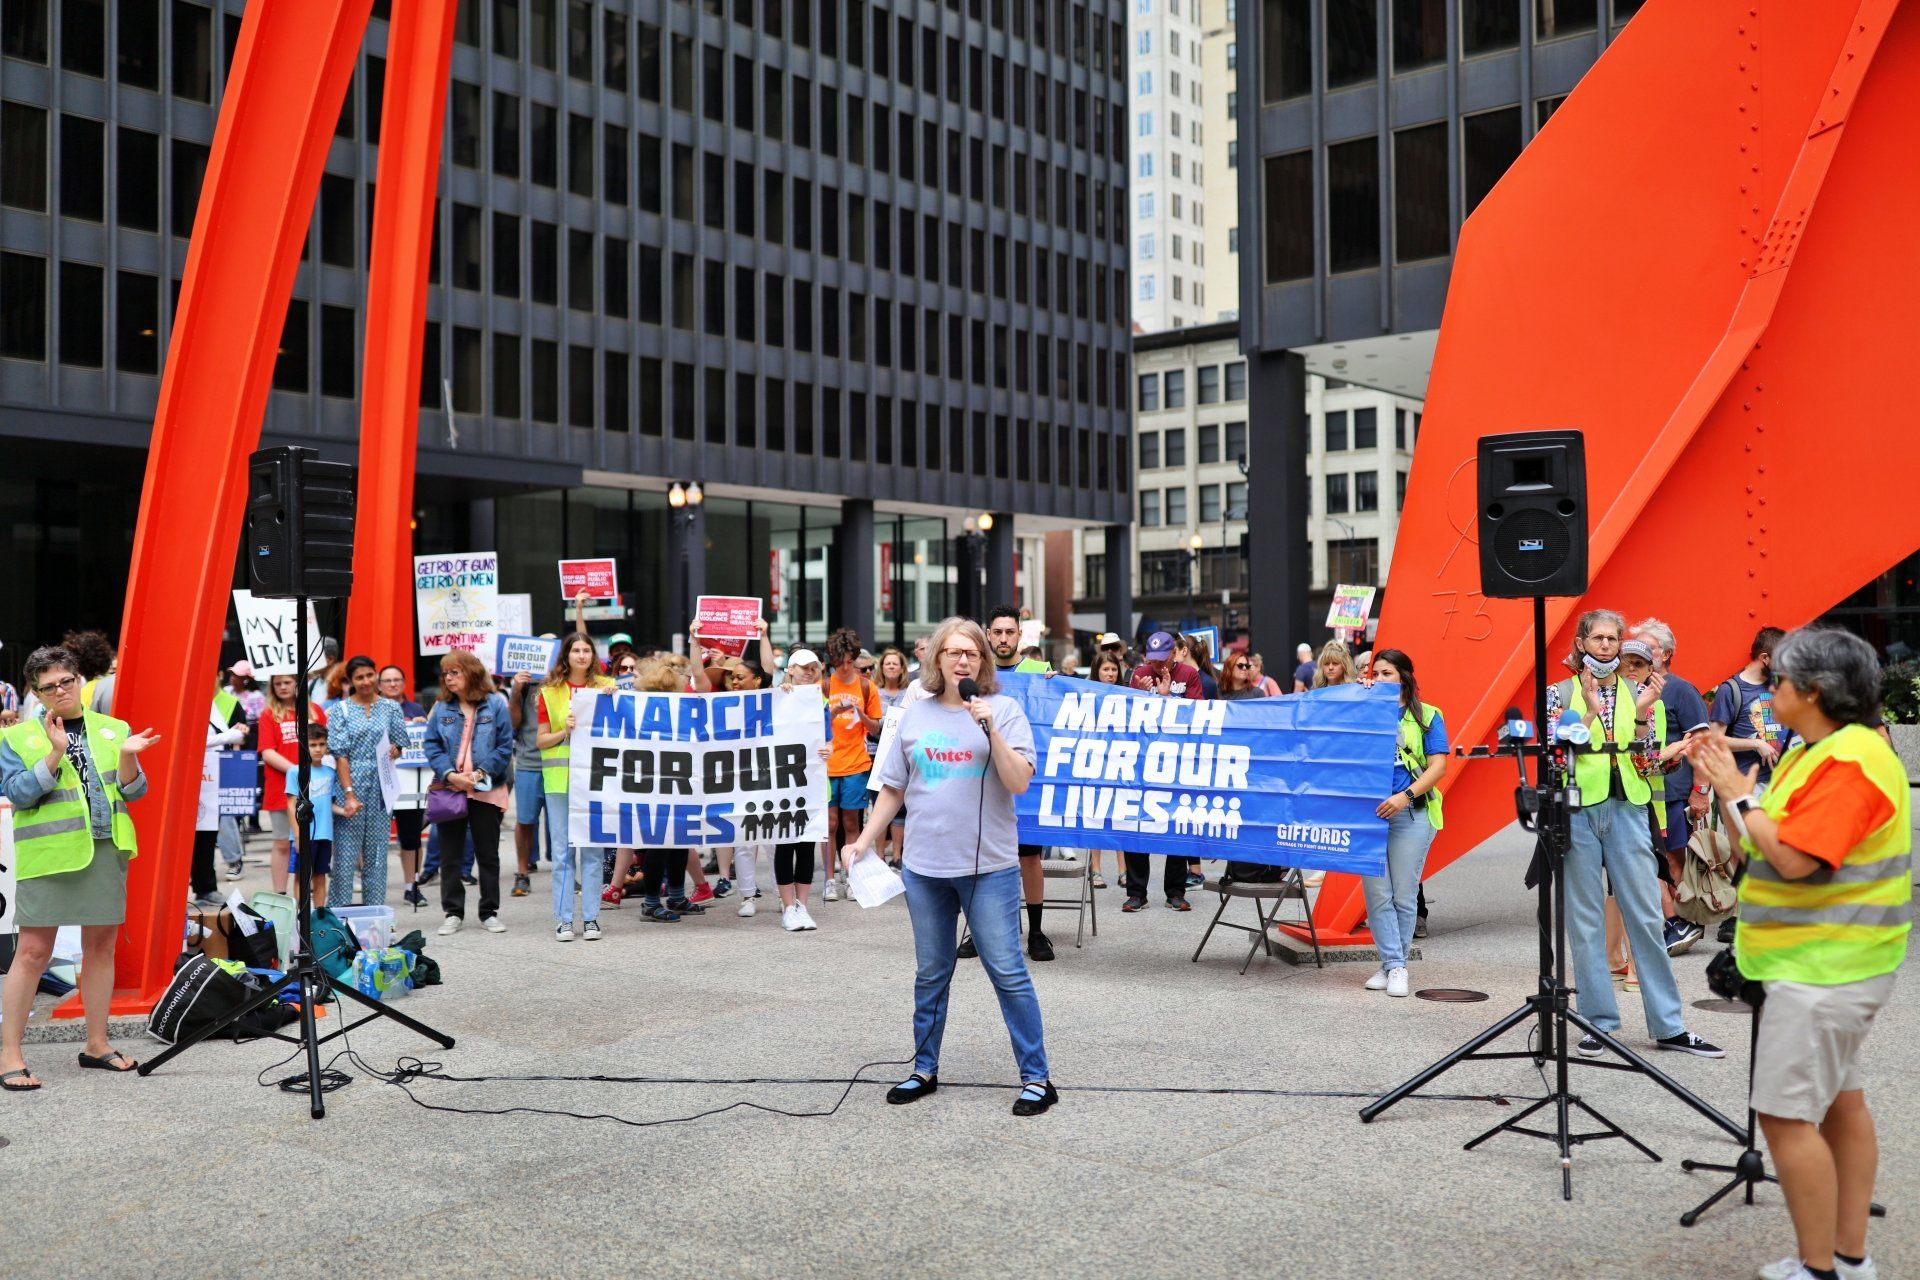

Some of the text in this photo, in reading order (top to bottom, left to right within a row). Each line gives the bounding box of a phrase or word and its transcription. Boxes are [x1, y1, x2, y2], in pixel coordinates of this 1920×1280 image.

[417, 558, 495, 575] GET RID OF GUNS
[417, 573, 494, 589] GET RID OF MEN
[246, 615, 283, 643] MY
[446, 620, 473, 630] PRETTY
[424, 634, 442, 647] WE
[508, 642, 542, 652] MARCH
[507, 651, 546, 662] FOR OUR
[506, 661, 532, 670] LIVES
[590, 692, 774, 742] MARCH
[1052, 691, 1227, 736] MARCH
[1514, 720, 1527, 737] 9
[925, 747, 973, 763] Votes
[1044, 736, 1141, 782] FOR
[1142, 741, 1251, 789] OUR
[589, 743, 808, 795] FOR OUR
[1038, 784, 1174, 835] LIVES
[589, 800, 735, 846] LIVES
[1277, 823, 1351, 847] GIFFORDS
